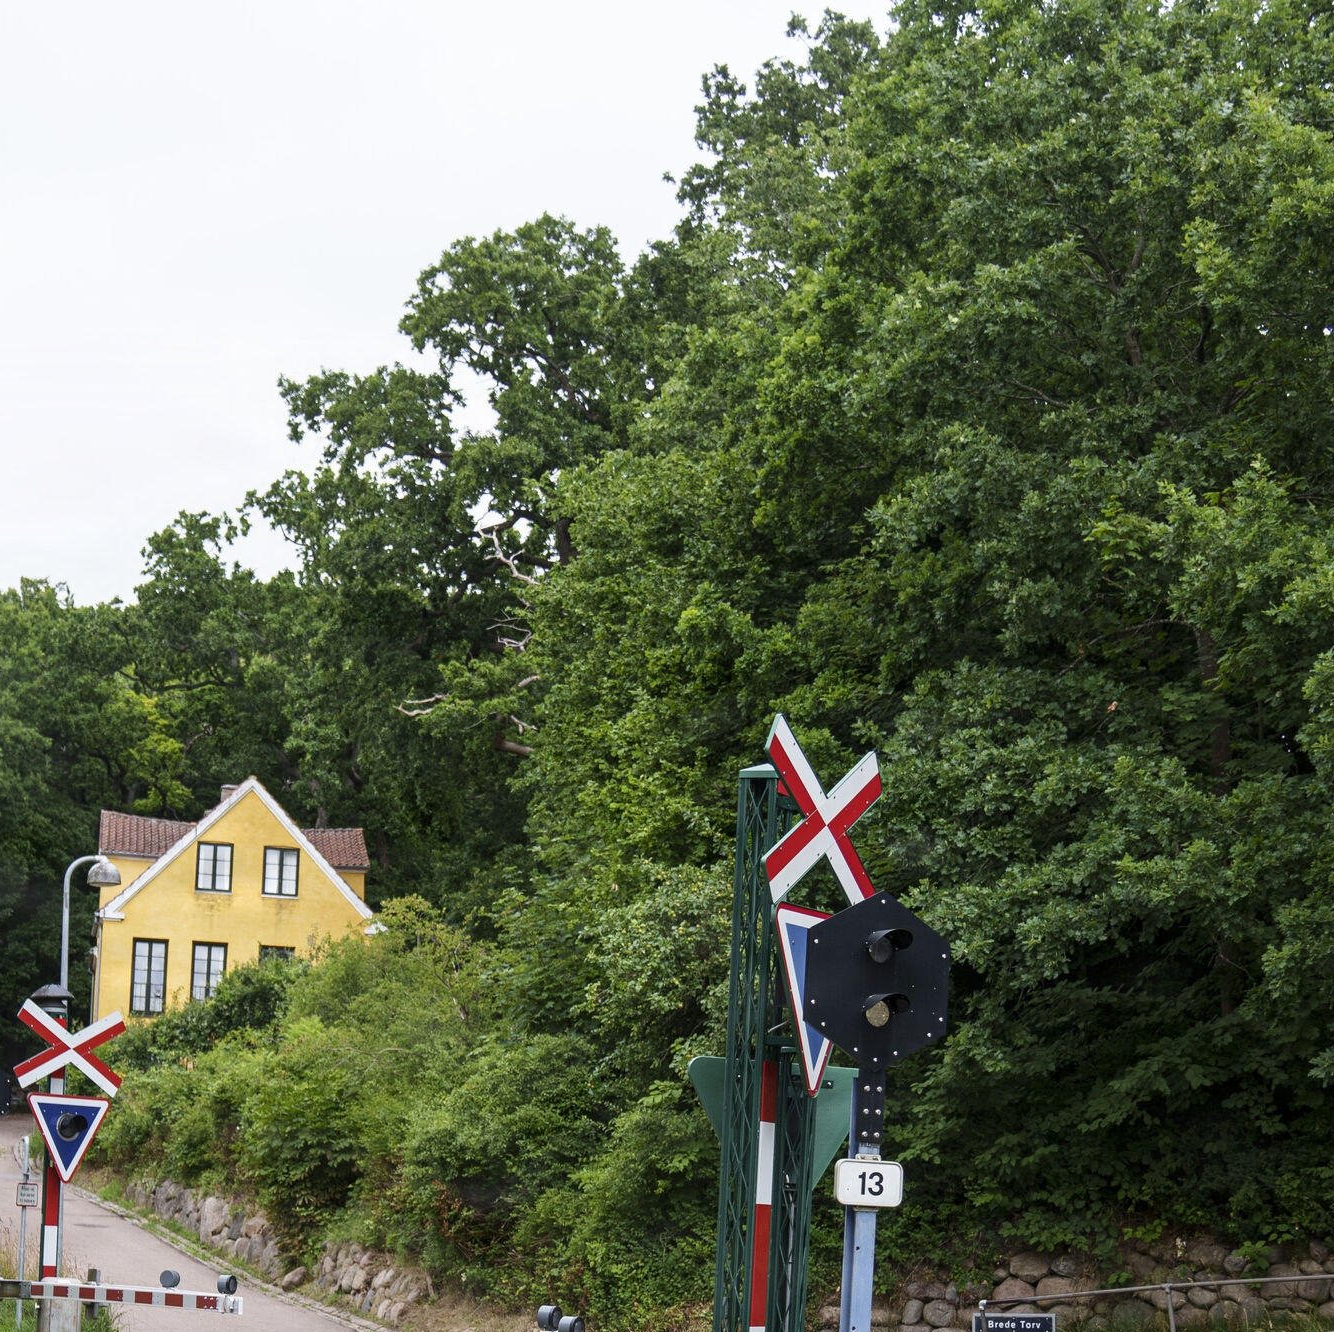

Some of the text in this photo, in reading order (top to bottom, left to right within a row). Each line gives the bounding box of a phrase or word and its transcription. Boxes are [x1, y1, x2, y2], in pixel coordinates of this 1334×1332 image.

[857, 1170, 884, 1196] 13
[987, 1320, 1041, 1329] Brede Torv
